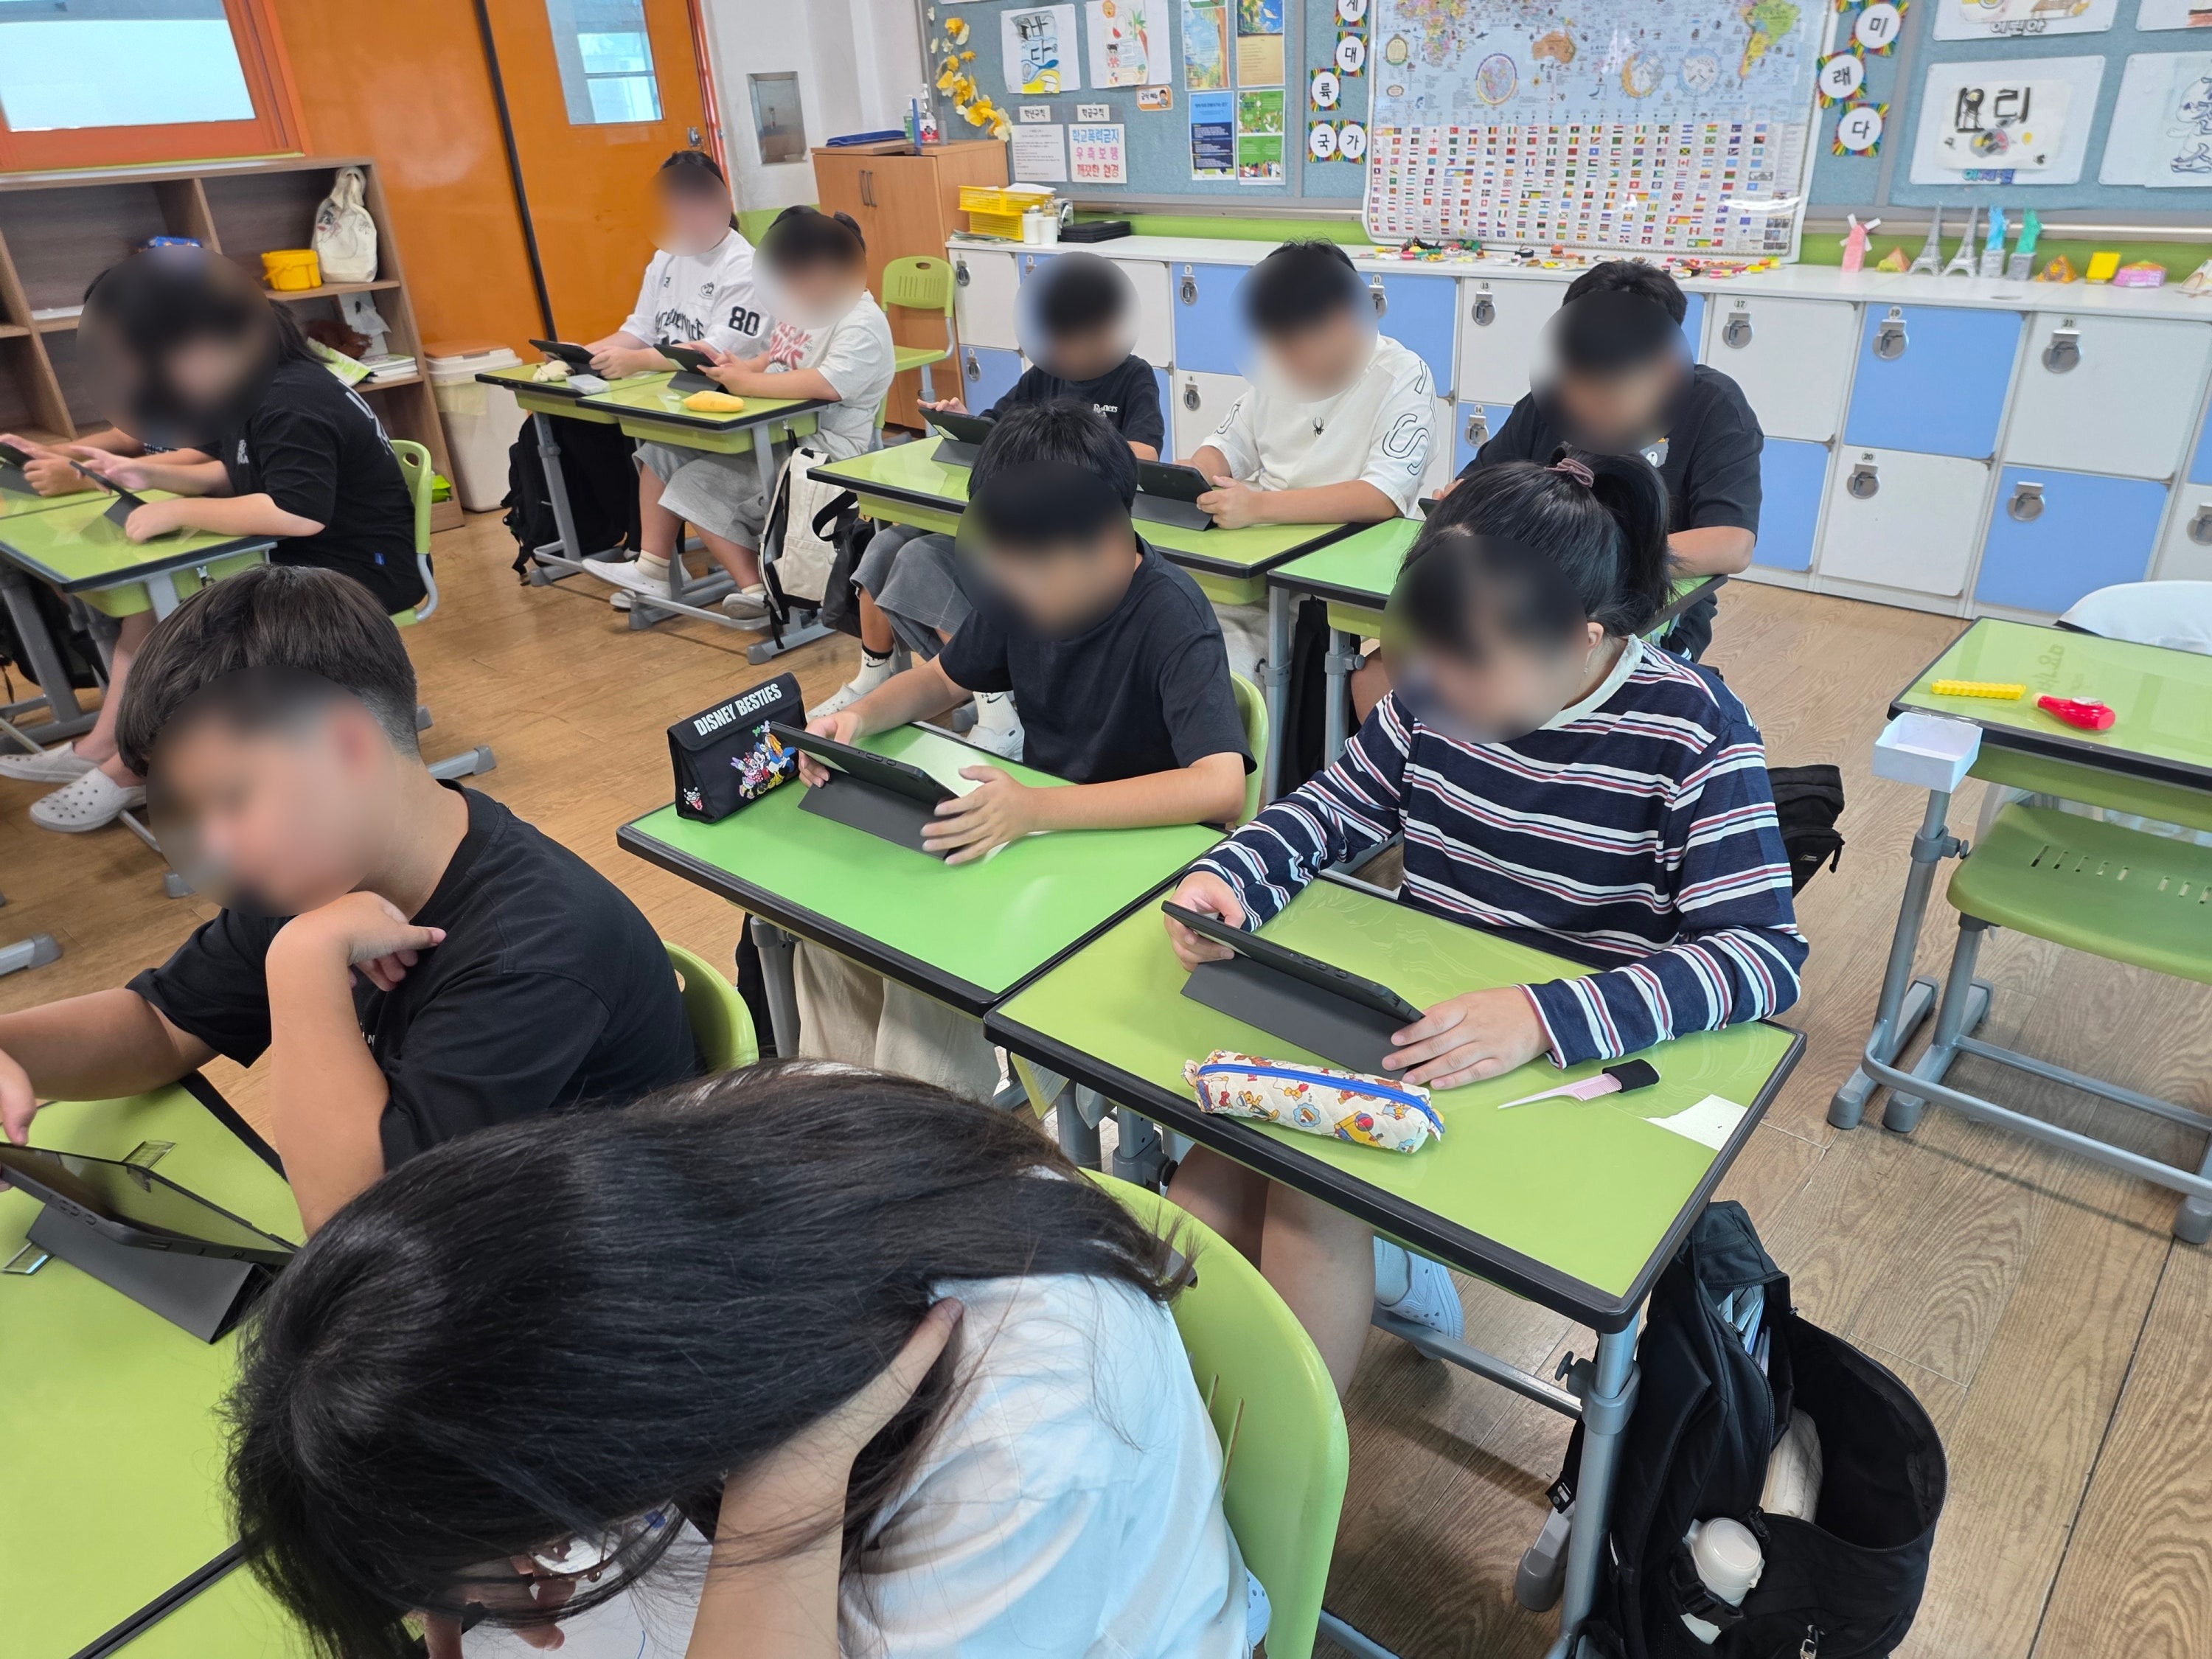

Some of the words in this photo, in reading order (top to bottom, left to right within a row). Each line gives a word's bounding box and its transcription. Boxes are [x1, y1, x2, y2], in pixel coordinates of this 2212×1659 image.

[1869, 18, 1890, 38] 미
[1344, 47, 1357, 63] 대
[1832, 66, 1851, 86] 래
[1319, 83, 1332, 100] 륙
[1852, 120, 1871, 139] 다
[728, 306, 760, 336] 80
[693, 703, 737, 736] DISNEY
[734, 683, 782, 717] BESTIES
